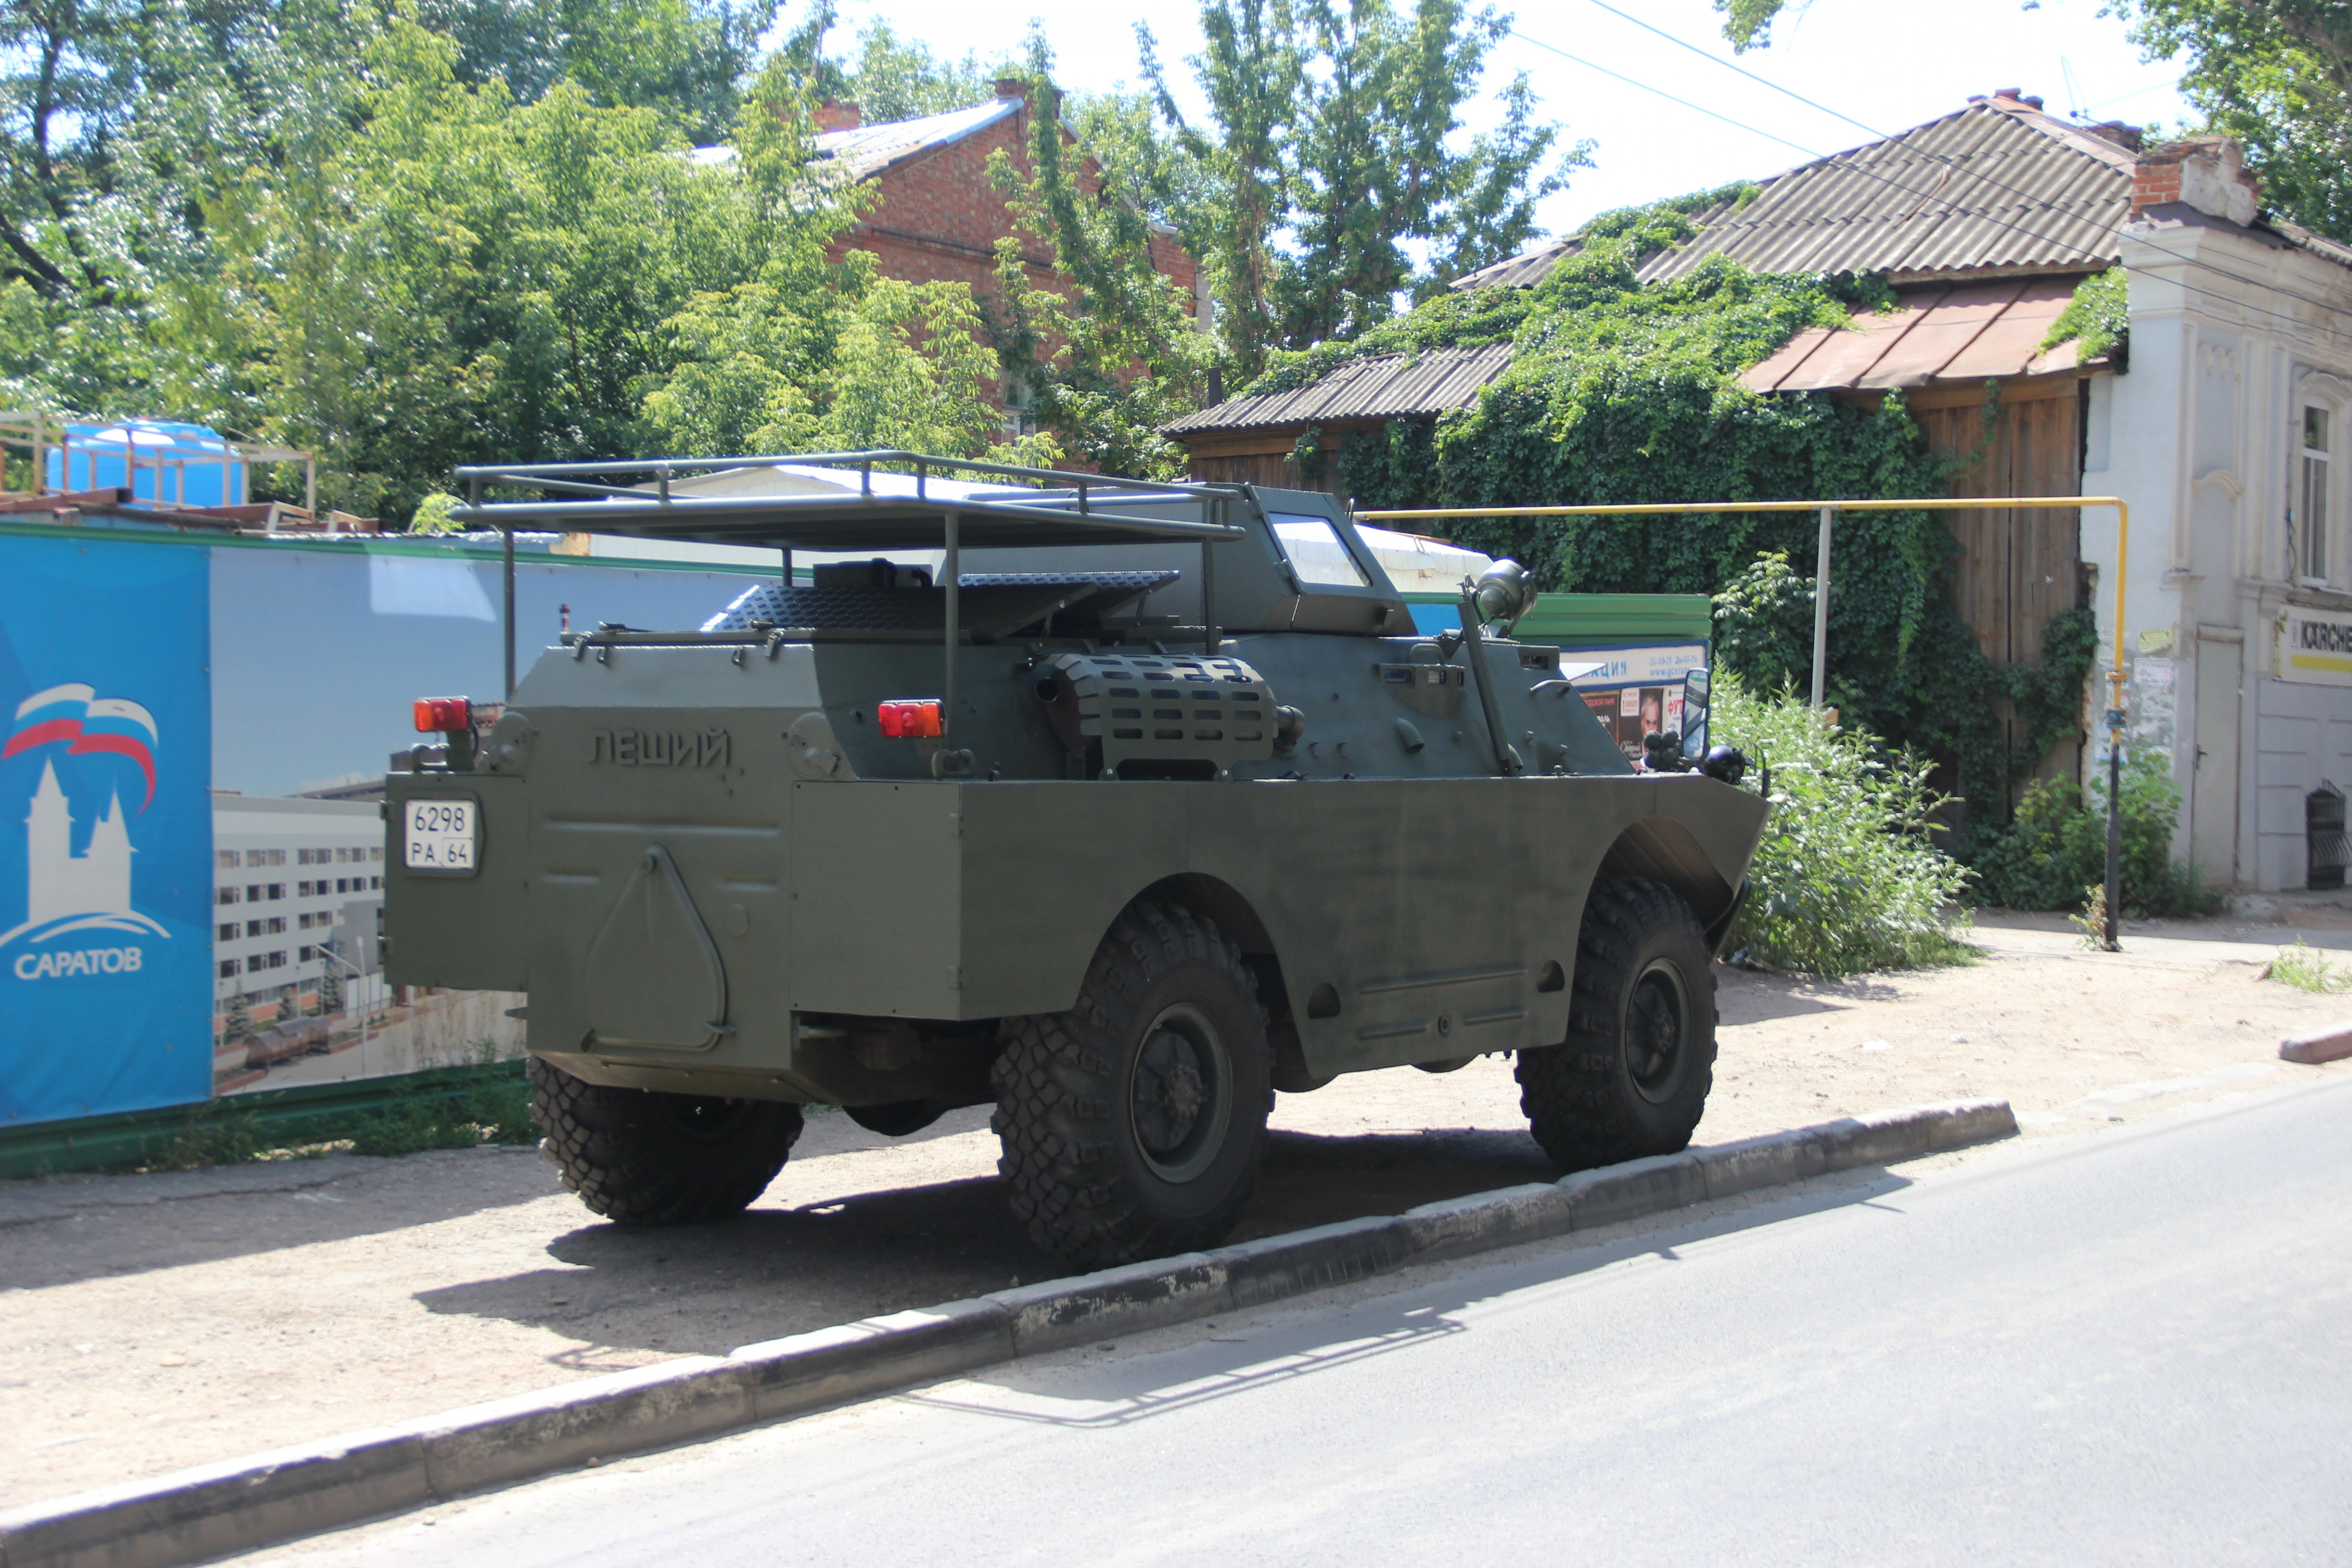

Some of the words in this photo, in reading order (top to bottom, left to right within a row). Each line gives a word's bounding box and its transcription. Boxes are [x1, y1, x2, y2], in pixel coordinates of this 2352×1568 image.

[588, 727, 730, 765] ЛЕШИЙ
[415, 806, 464, 832] 6298
[412, 843, 436, 862] РА
[448, 844, 467, 863] 64
[14, 946, 142, 980] САРАТОВ
